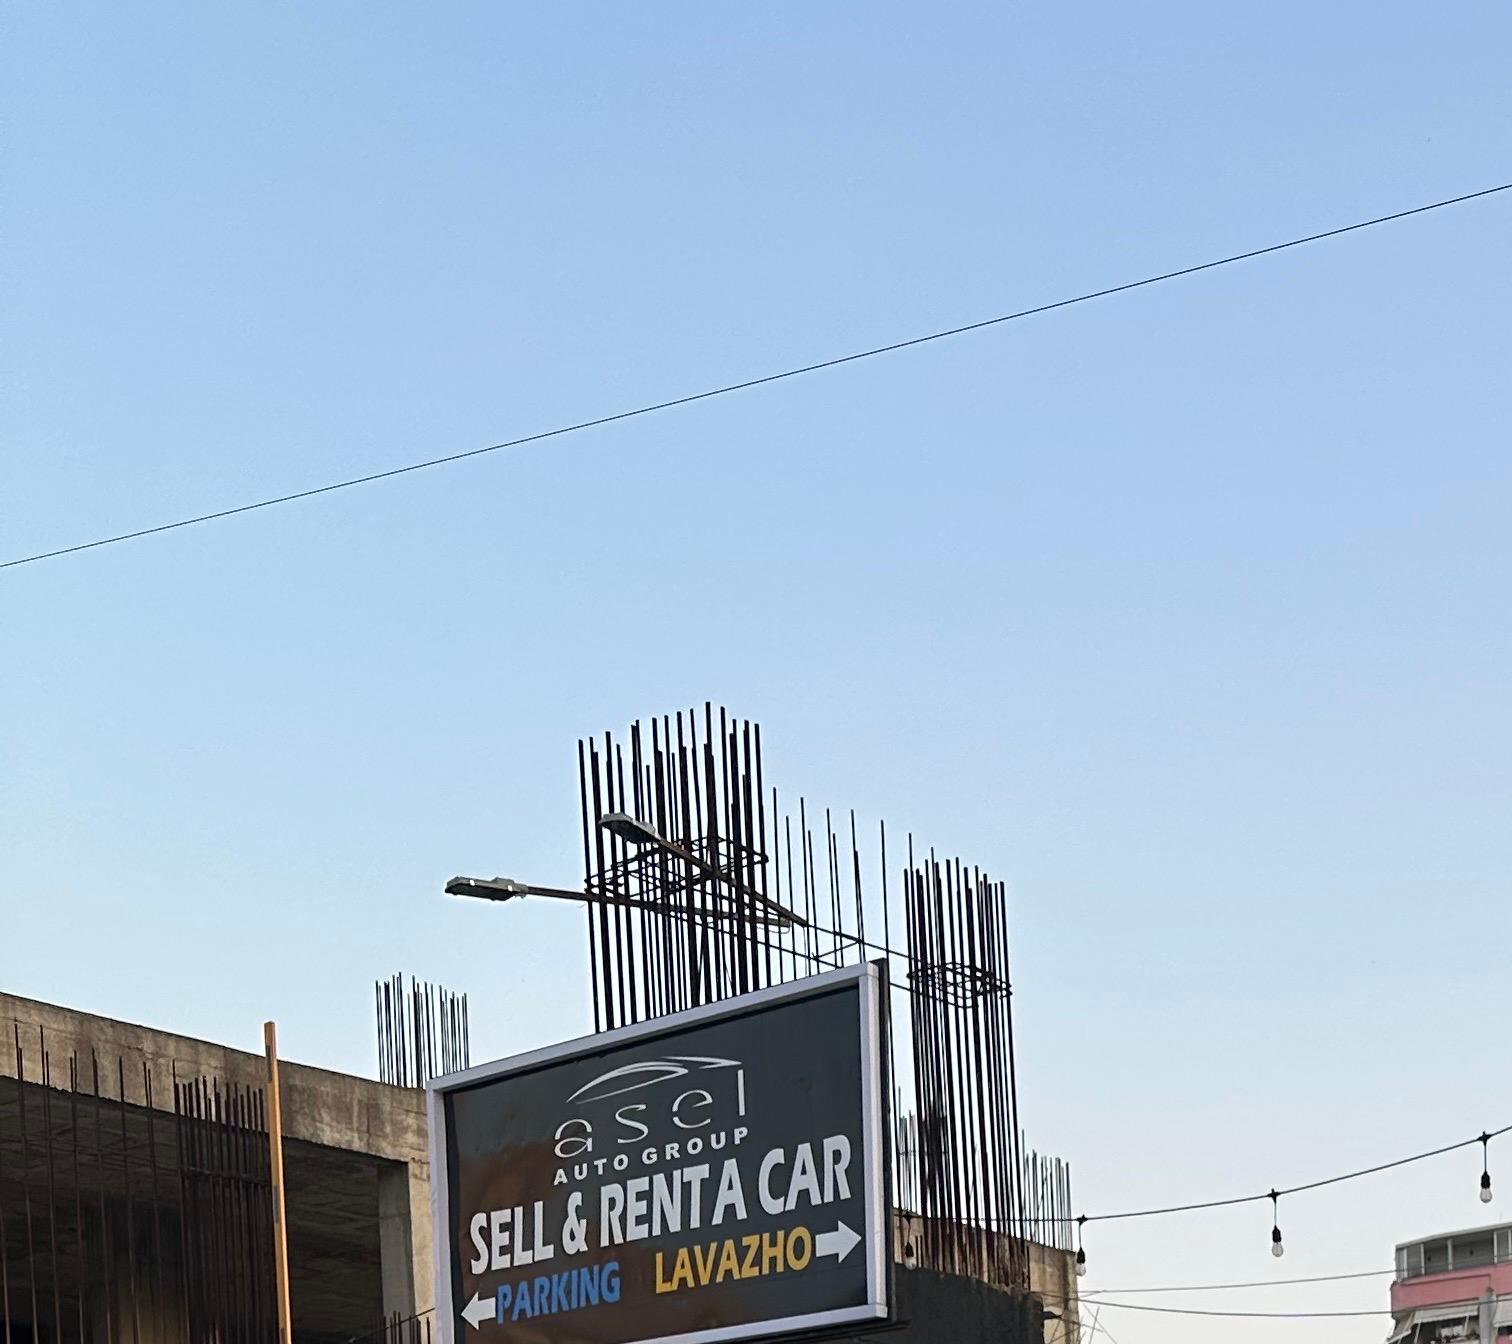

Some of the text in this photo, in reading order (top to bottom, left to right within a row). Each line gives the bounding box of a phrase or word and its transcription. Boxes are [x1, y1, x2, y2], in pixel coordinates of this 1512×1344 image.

[553, 1127, 749, 1186] AUTO GROUP
[470, 1134, 852, 1276] SELL & RENT A CAR
[655, 1226, 813, 1295] LAVAZHO
[495, 1262, 621, 1326] PARKING
